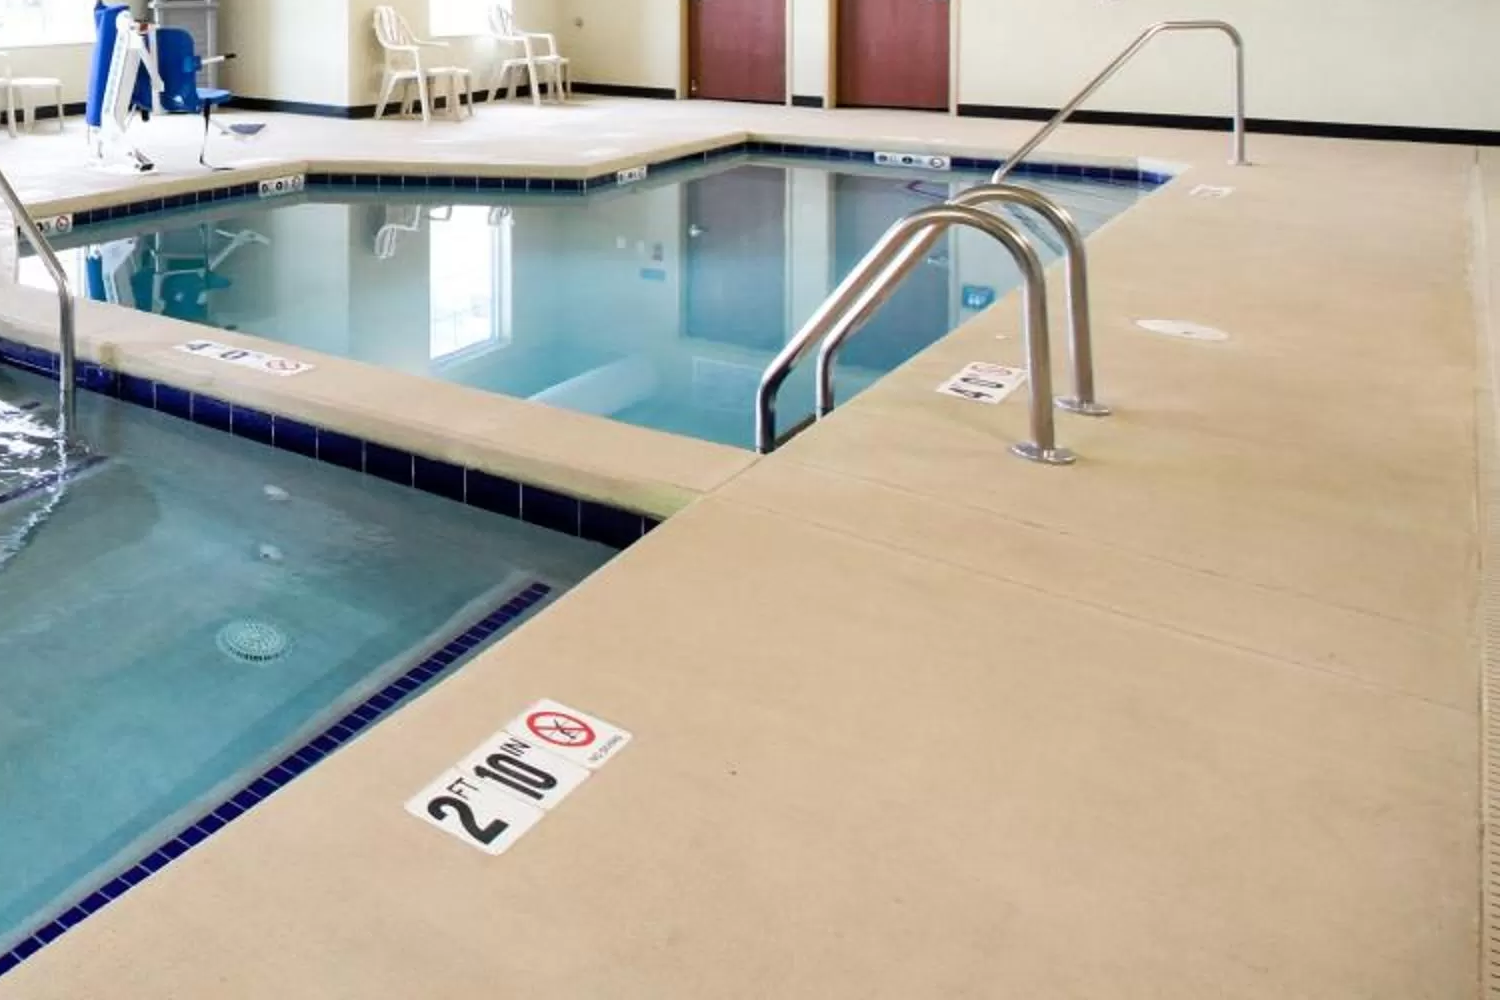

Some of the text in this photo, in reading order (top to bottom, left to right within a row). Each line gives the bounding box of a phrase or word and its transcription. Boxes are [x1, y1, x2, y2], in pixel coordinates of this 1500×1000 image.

[427, 737, 558, 845] 2 FT 10 IN
